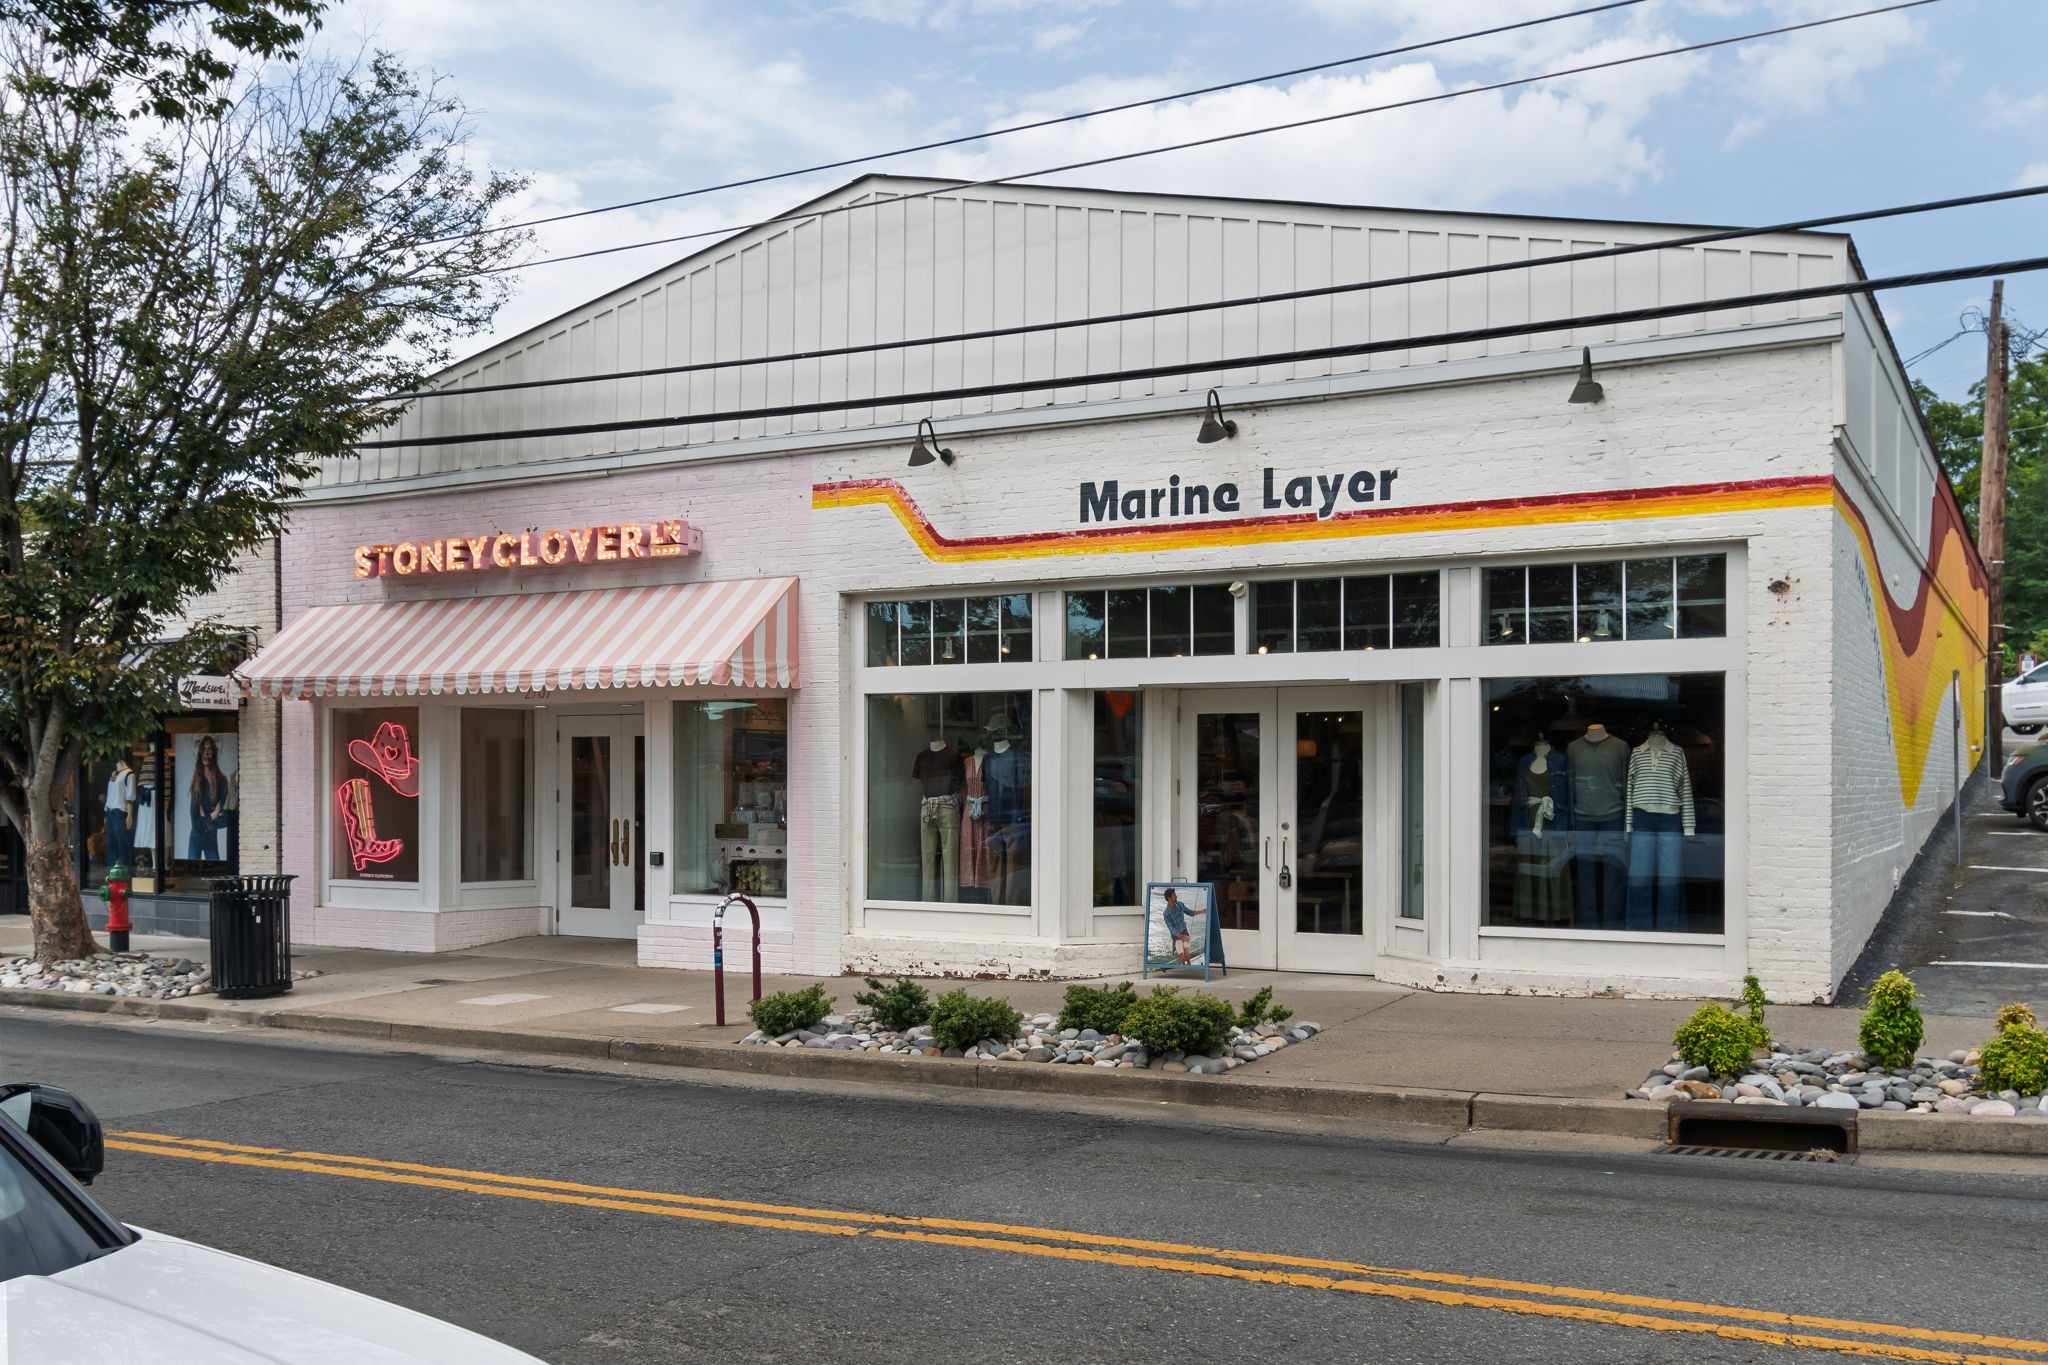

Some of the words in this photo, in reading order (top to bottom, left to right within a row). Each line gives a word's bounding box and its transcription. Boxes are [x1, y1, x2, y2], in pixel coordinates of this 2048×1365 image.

[1080, 474, 1240, 523] Marine
[1263, 467, 1398, 518] Layer
[651, 520, 685, 546] LN
[213, 697, 231, 705] edit
